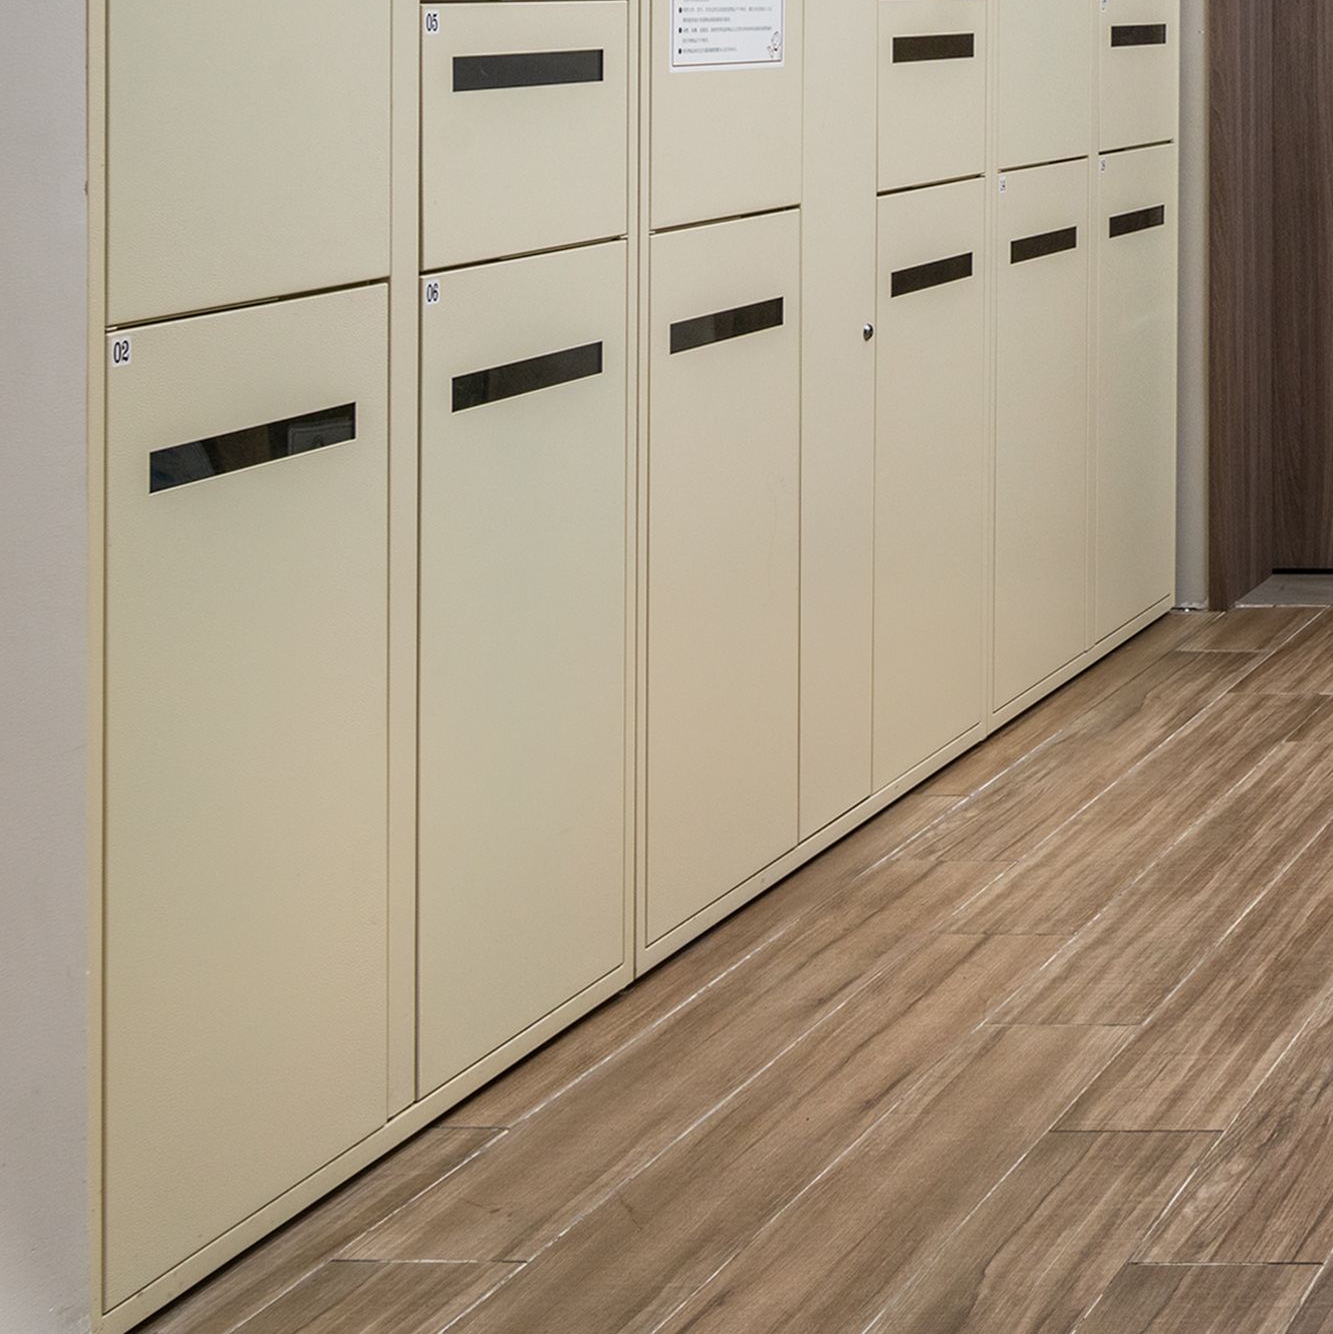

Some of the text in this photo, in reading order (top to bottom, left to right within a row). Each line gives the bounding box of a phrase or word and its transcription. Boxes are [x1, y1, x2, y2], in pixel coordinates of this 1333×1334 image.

[426, 12, 438, 32] 05
[426, 282, 438, 303] 06
[113, 339, 130, 364] 02
